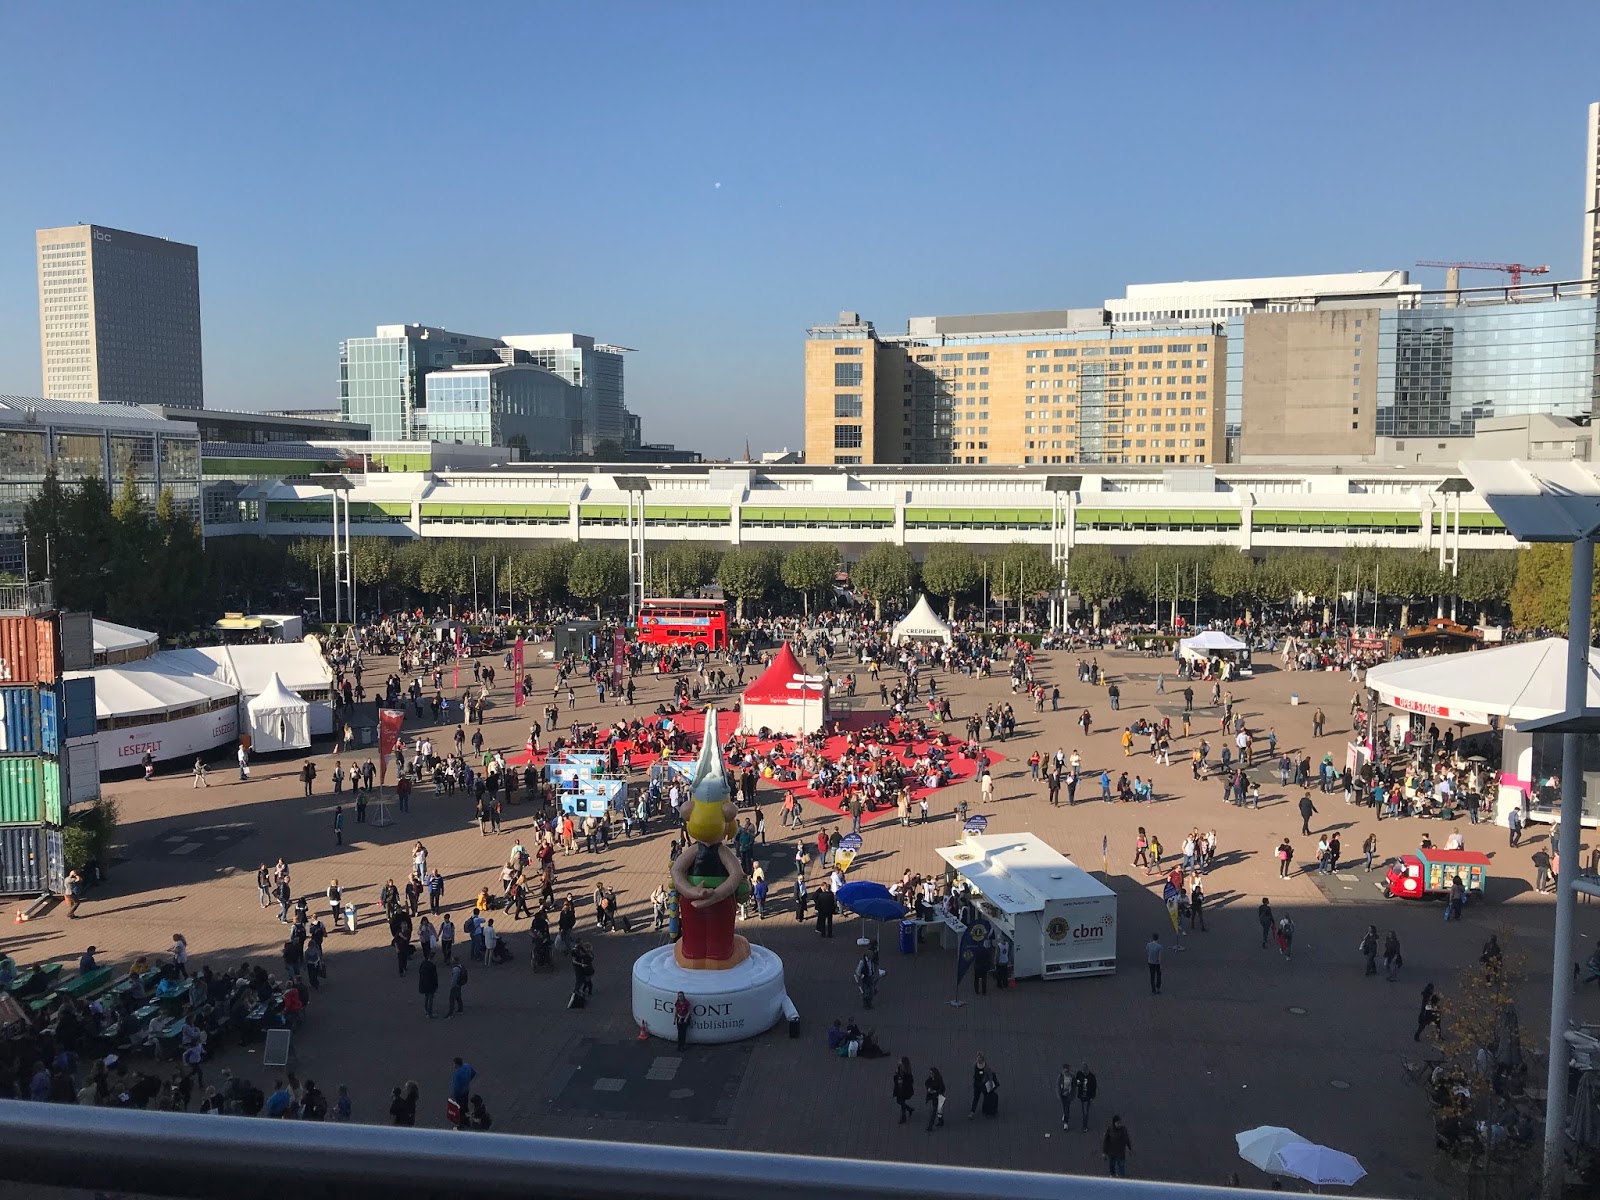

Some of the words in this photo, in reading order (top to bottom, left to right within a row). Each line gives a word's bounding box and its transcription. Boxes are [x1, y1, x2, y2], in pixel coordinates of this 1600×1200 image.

[93, 228, 112, 242] ibc
[1399, 698, 1415, 711] OPEN
[1416, 701, 1440, 714] STAGE
[212, 721, 236, 738] LESEZELT
[118, 740, 162, 757] LESEZELT
[1073, 923, 1103, 939] cbm
[653, 998, 733, 1017] EGONT
[691, 1018, 745, 1030] Publishing
